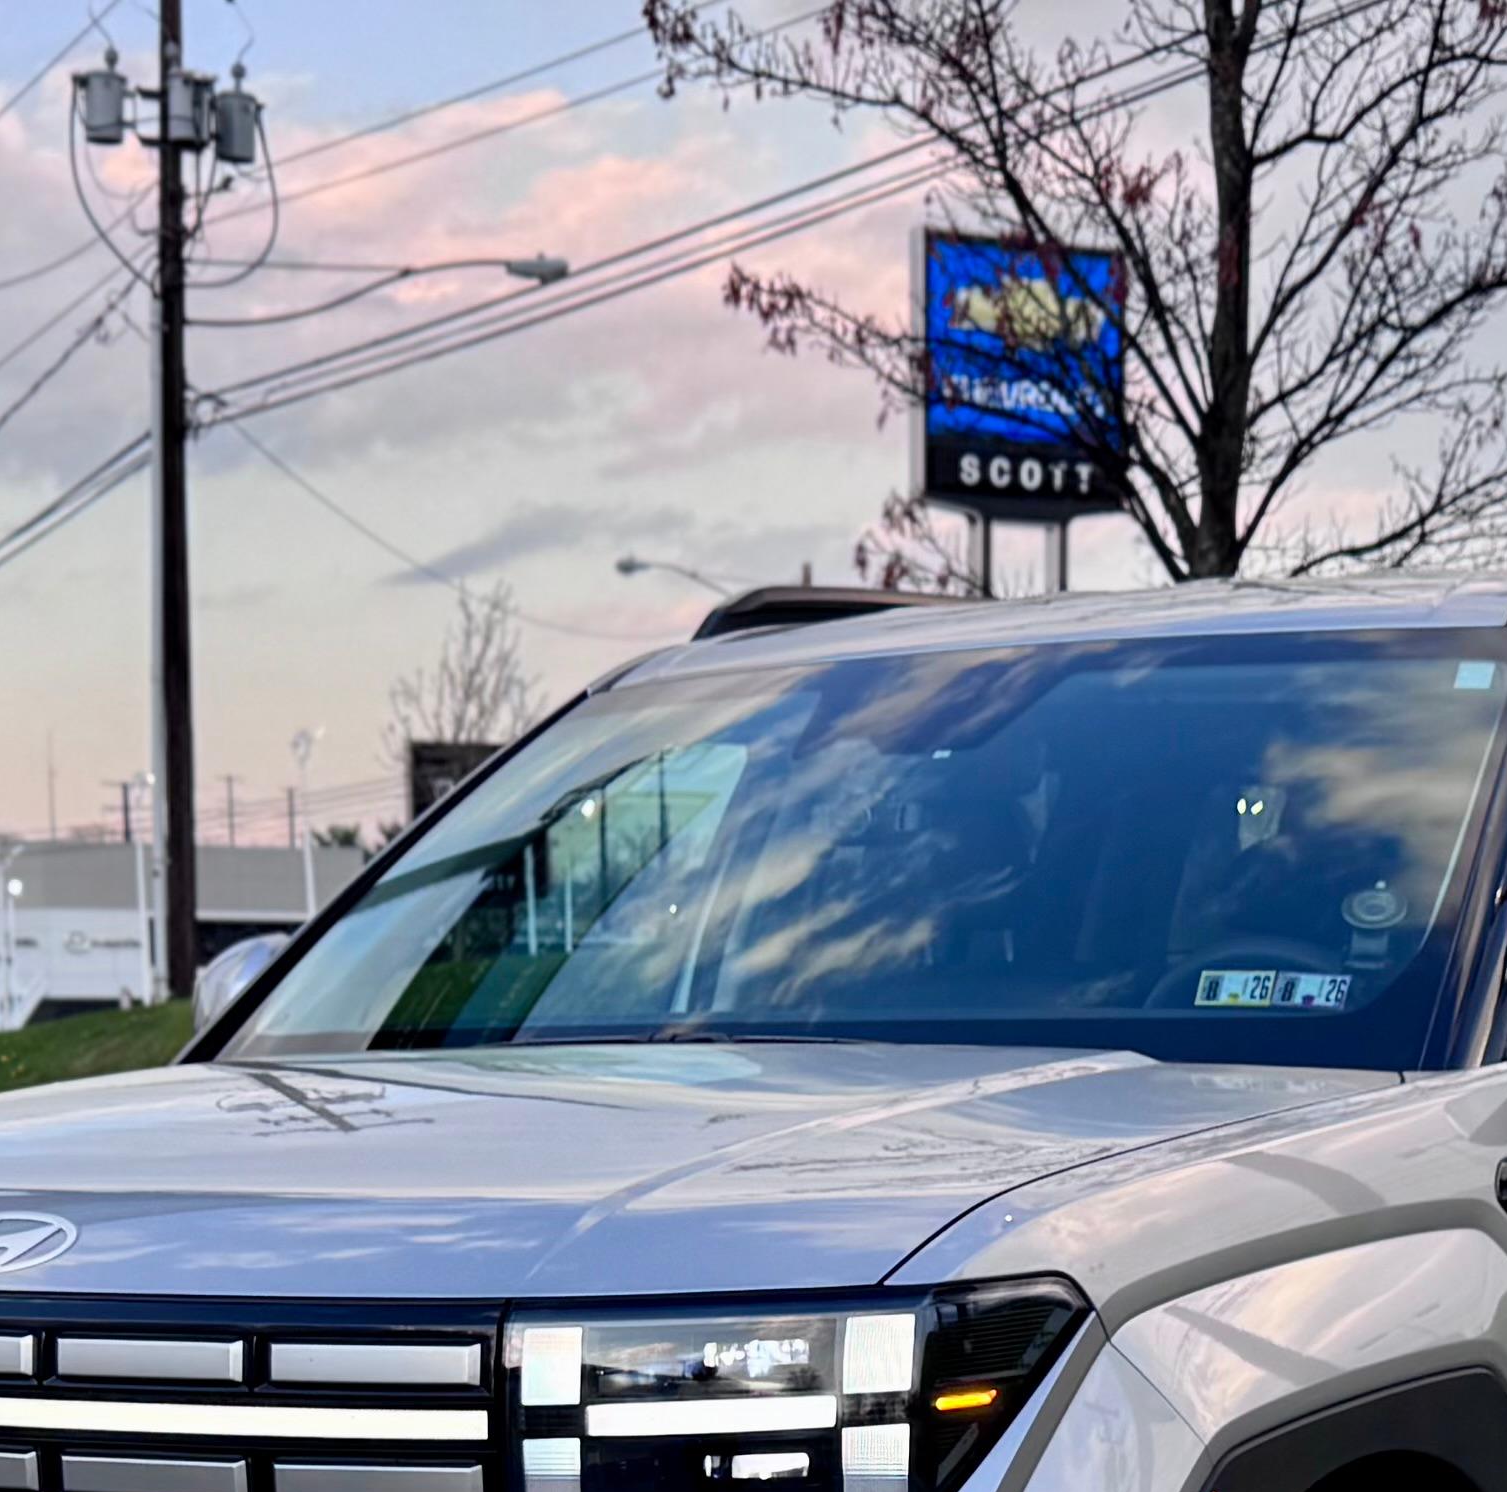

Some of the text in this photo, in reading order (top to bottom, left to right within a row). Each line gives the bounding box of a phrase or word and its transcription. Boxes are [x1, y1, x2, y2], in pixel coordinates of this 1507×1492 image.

[959, 452, 1093, 495] SCOTT
[1250, 974, 1271, 1001] 26
[1325, 979, 1348, 1004] 26
